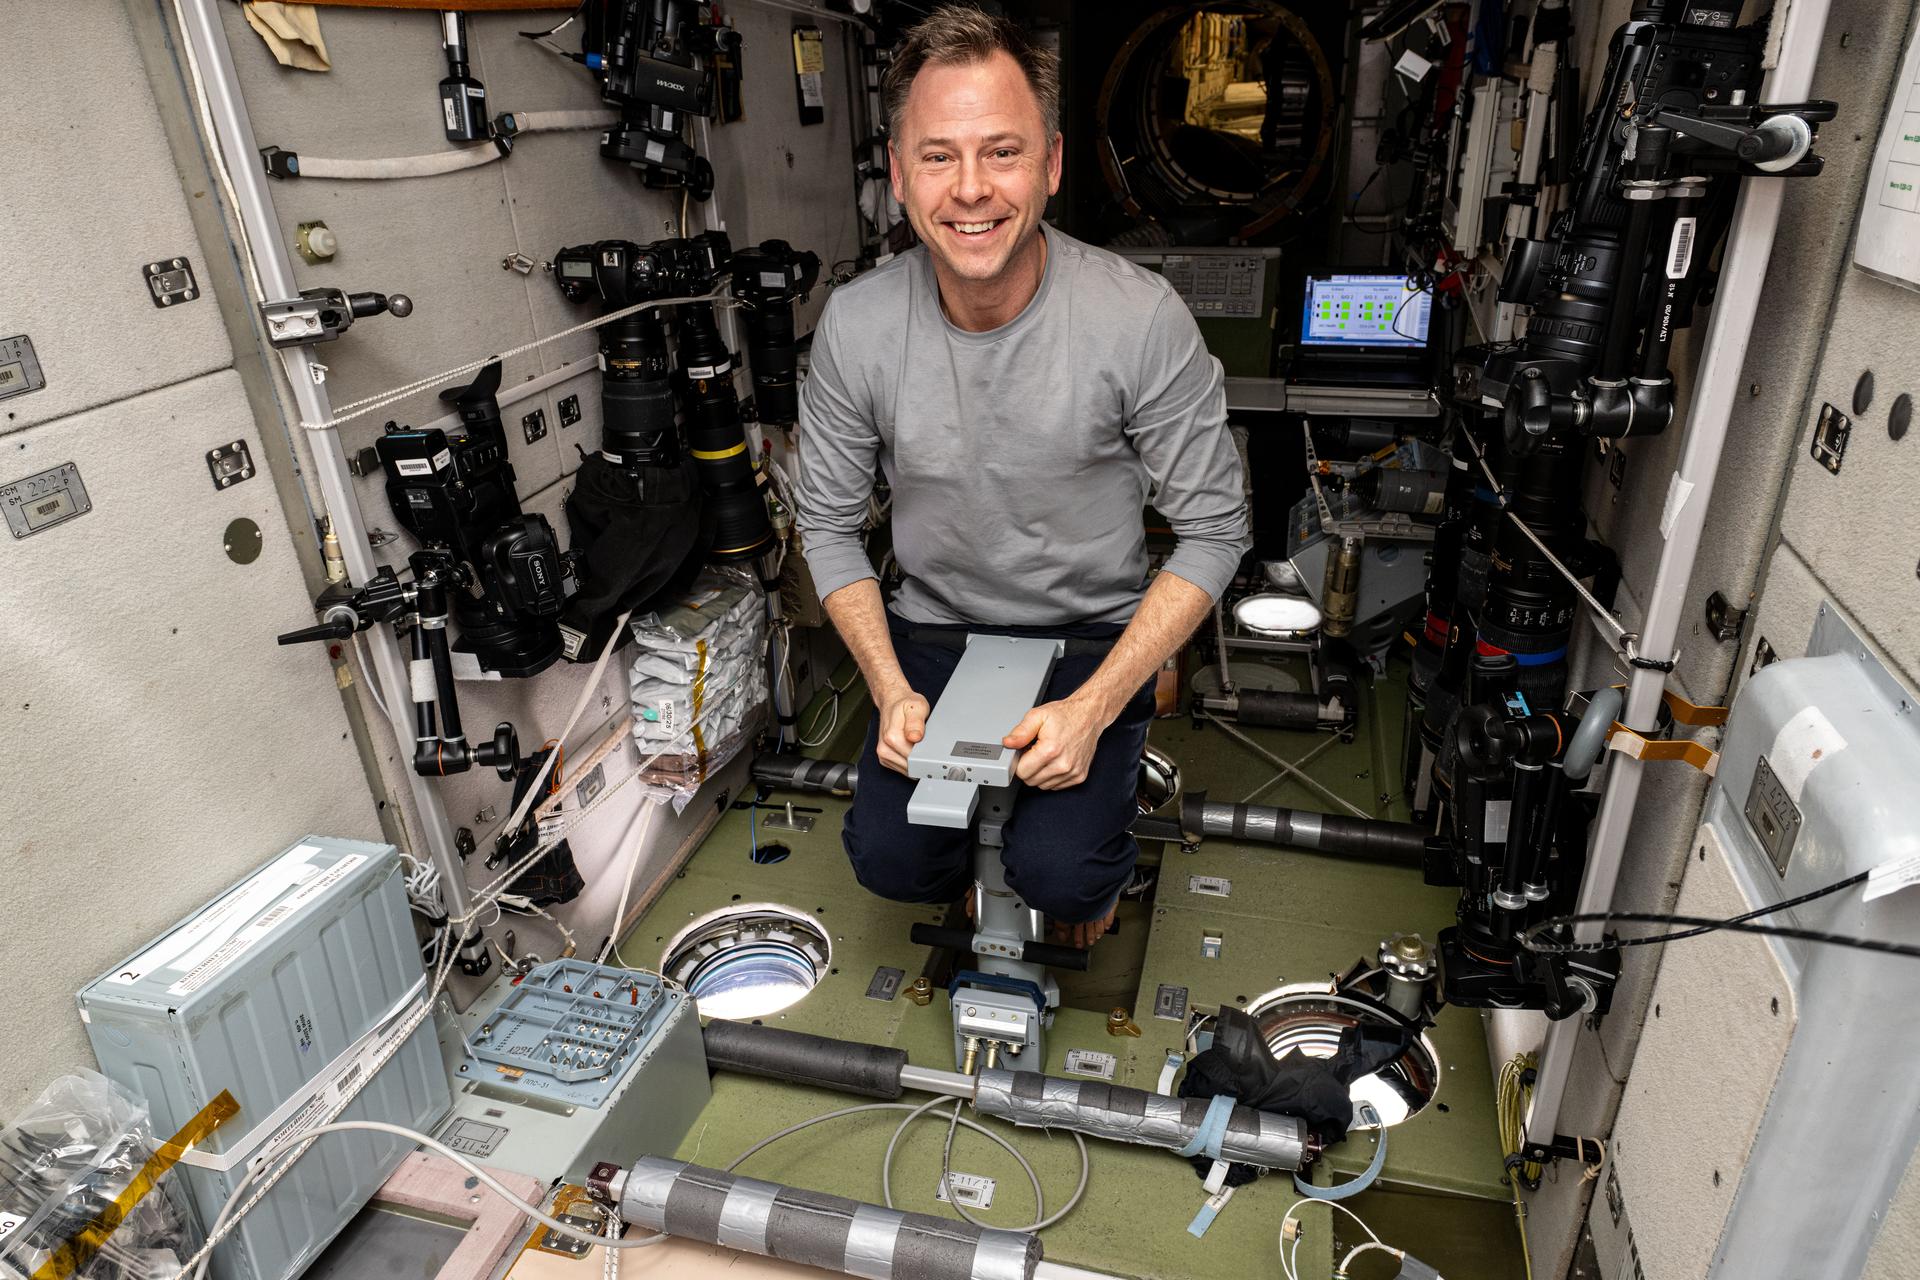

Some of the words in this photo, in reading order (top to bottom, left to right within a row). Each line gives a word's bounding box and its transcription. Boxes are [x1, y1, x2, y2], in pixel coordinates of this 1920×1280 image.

[26, 474, 60, 497] 222
[533, 560, 546, 585] SONY
[119, 971, 141, 981] 2
[179, 953, 220, 983] КОНТЕЙНЕР
[273, 1109, 309, 1143] КОНТЕЙНЕР
